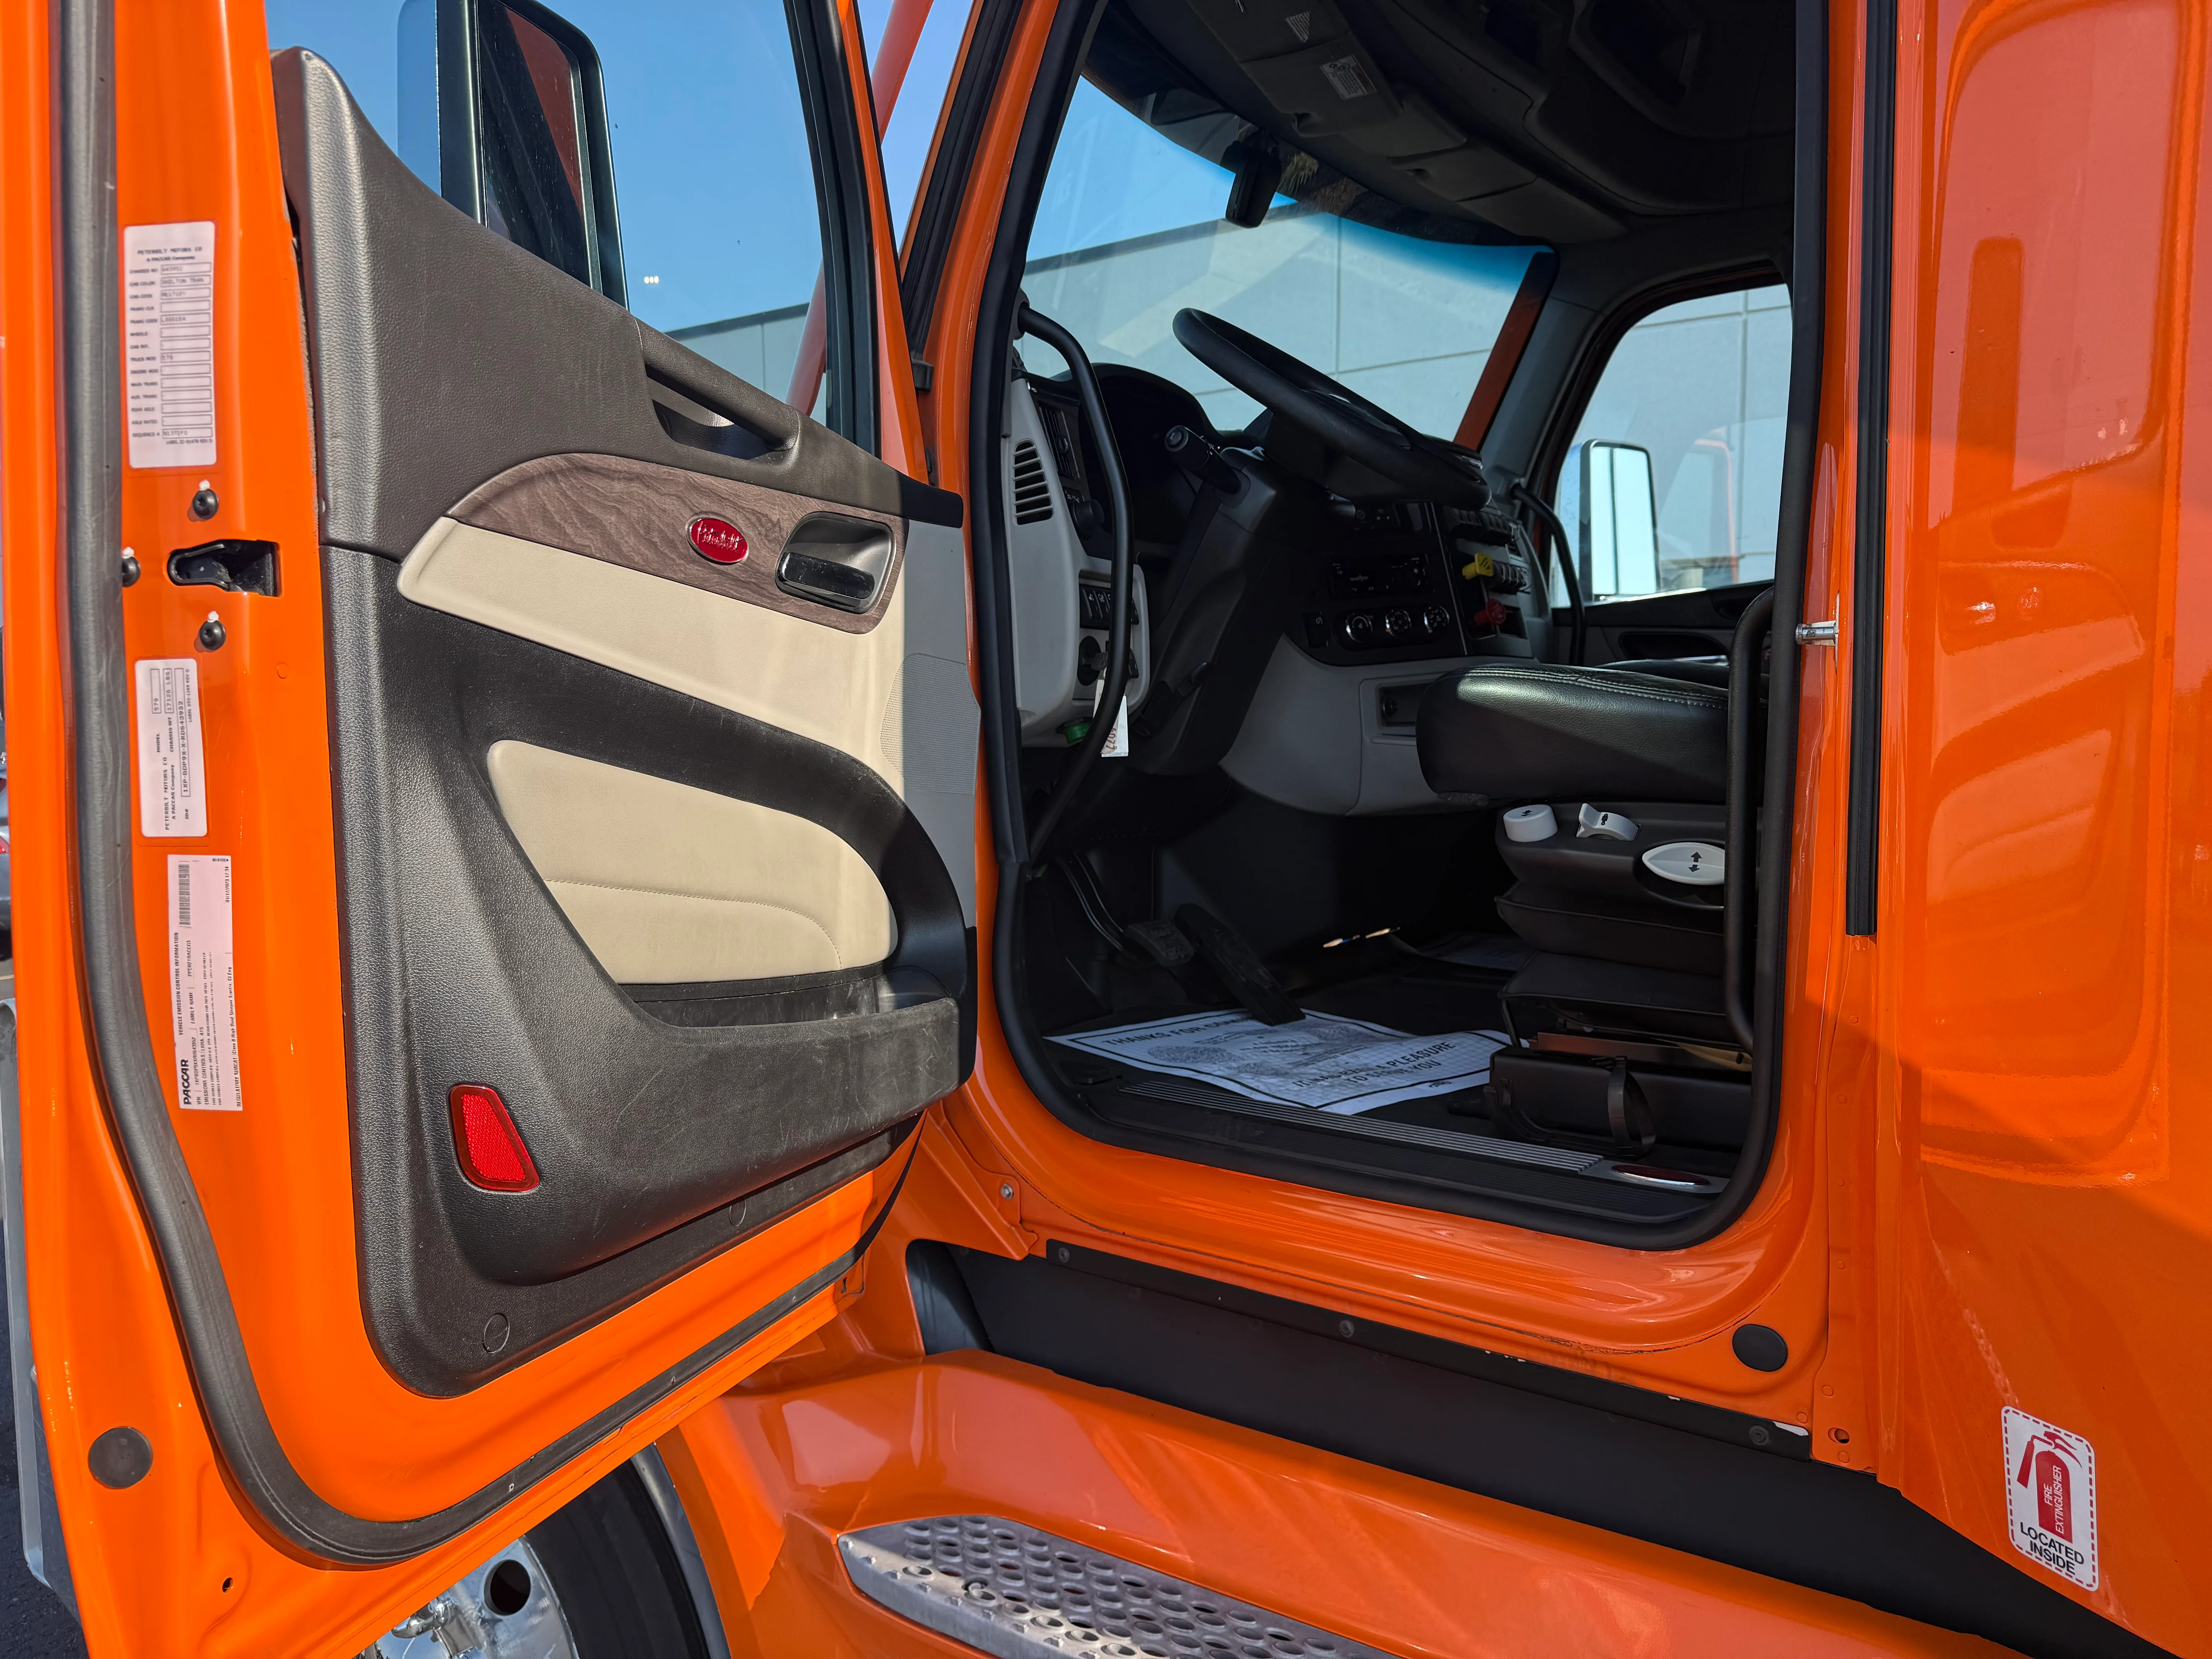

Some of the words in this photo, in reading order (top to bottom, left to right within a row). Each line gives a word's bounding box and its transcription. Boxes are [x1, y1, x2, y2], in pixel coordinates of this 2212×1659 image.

[168, 717, 173, 726] WT
[162, 757, 167, 765] CO
[1102, 1032, 1172, 1045] THANKS
[1170, 1027, 1206, 1035] FOR
[1386, 1041, 1456, 1067] PLEASURE
[1408, 1060, 1441, 1070] YOU
[180, 1059, 192, 1105] PACCAR
[2044, 1483, 2053, 1506] FIRE
[2052, 1465, 2064, 1535] EXTINGUISHER
[2020, 1522, 2084, 1565] LOCATED
[2030, 1540, 2075, 1575] INSIDE
